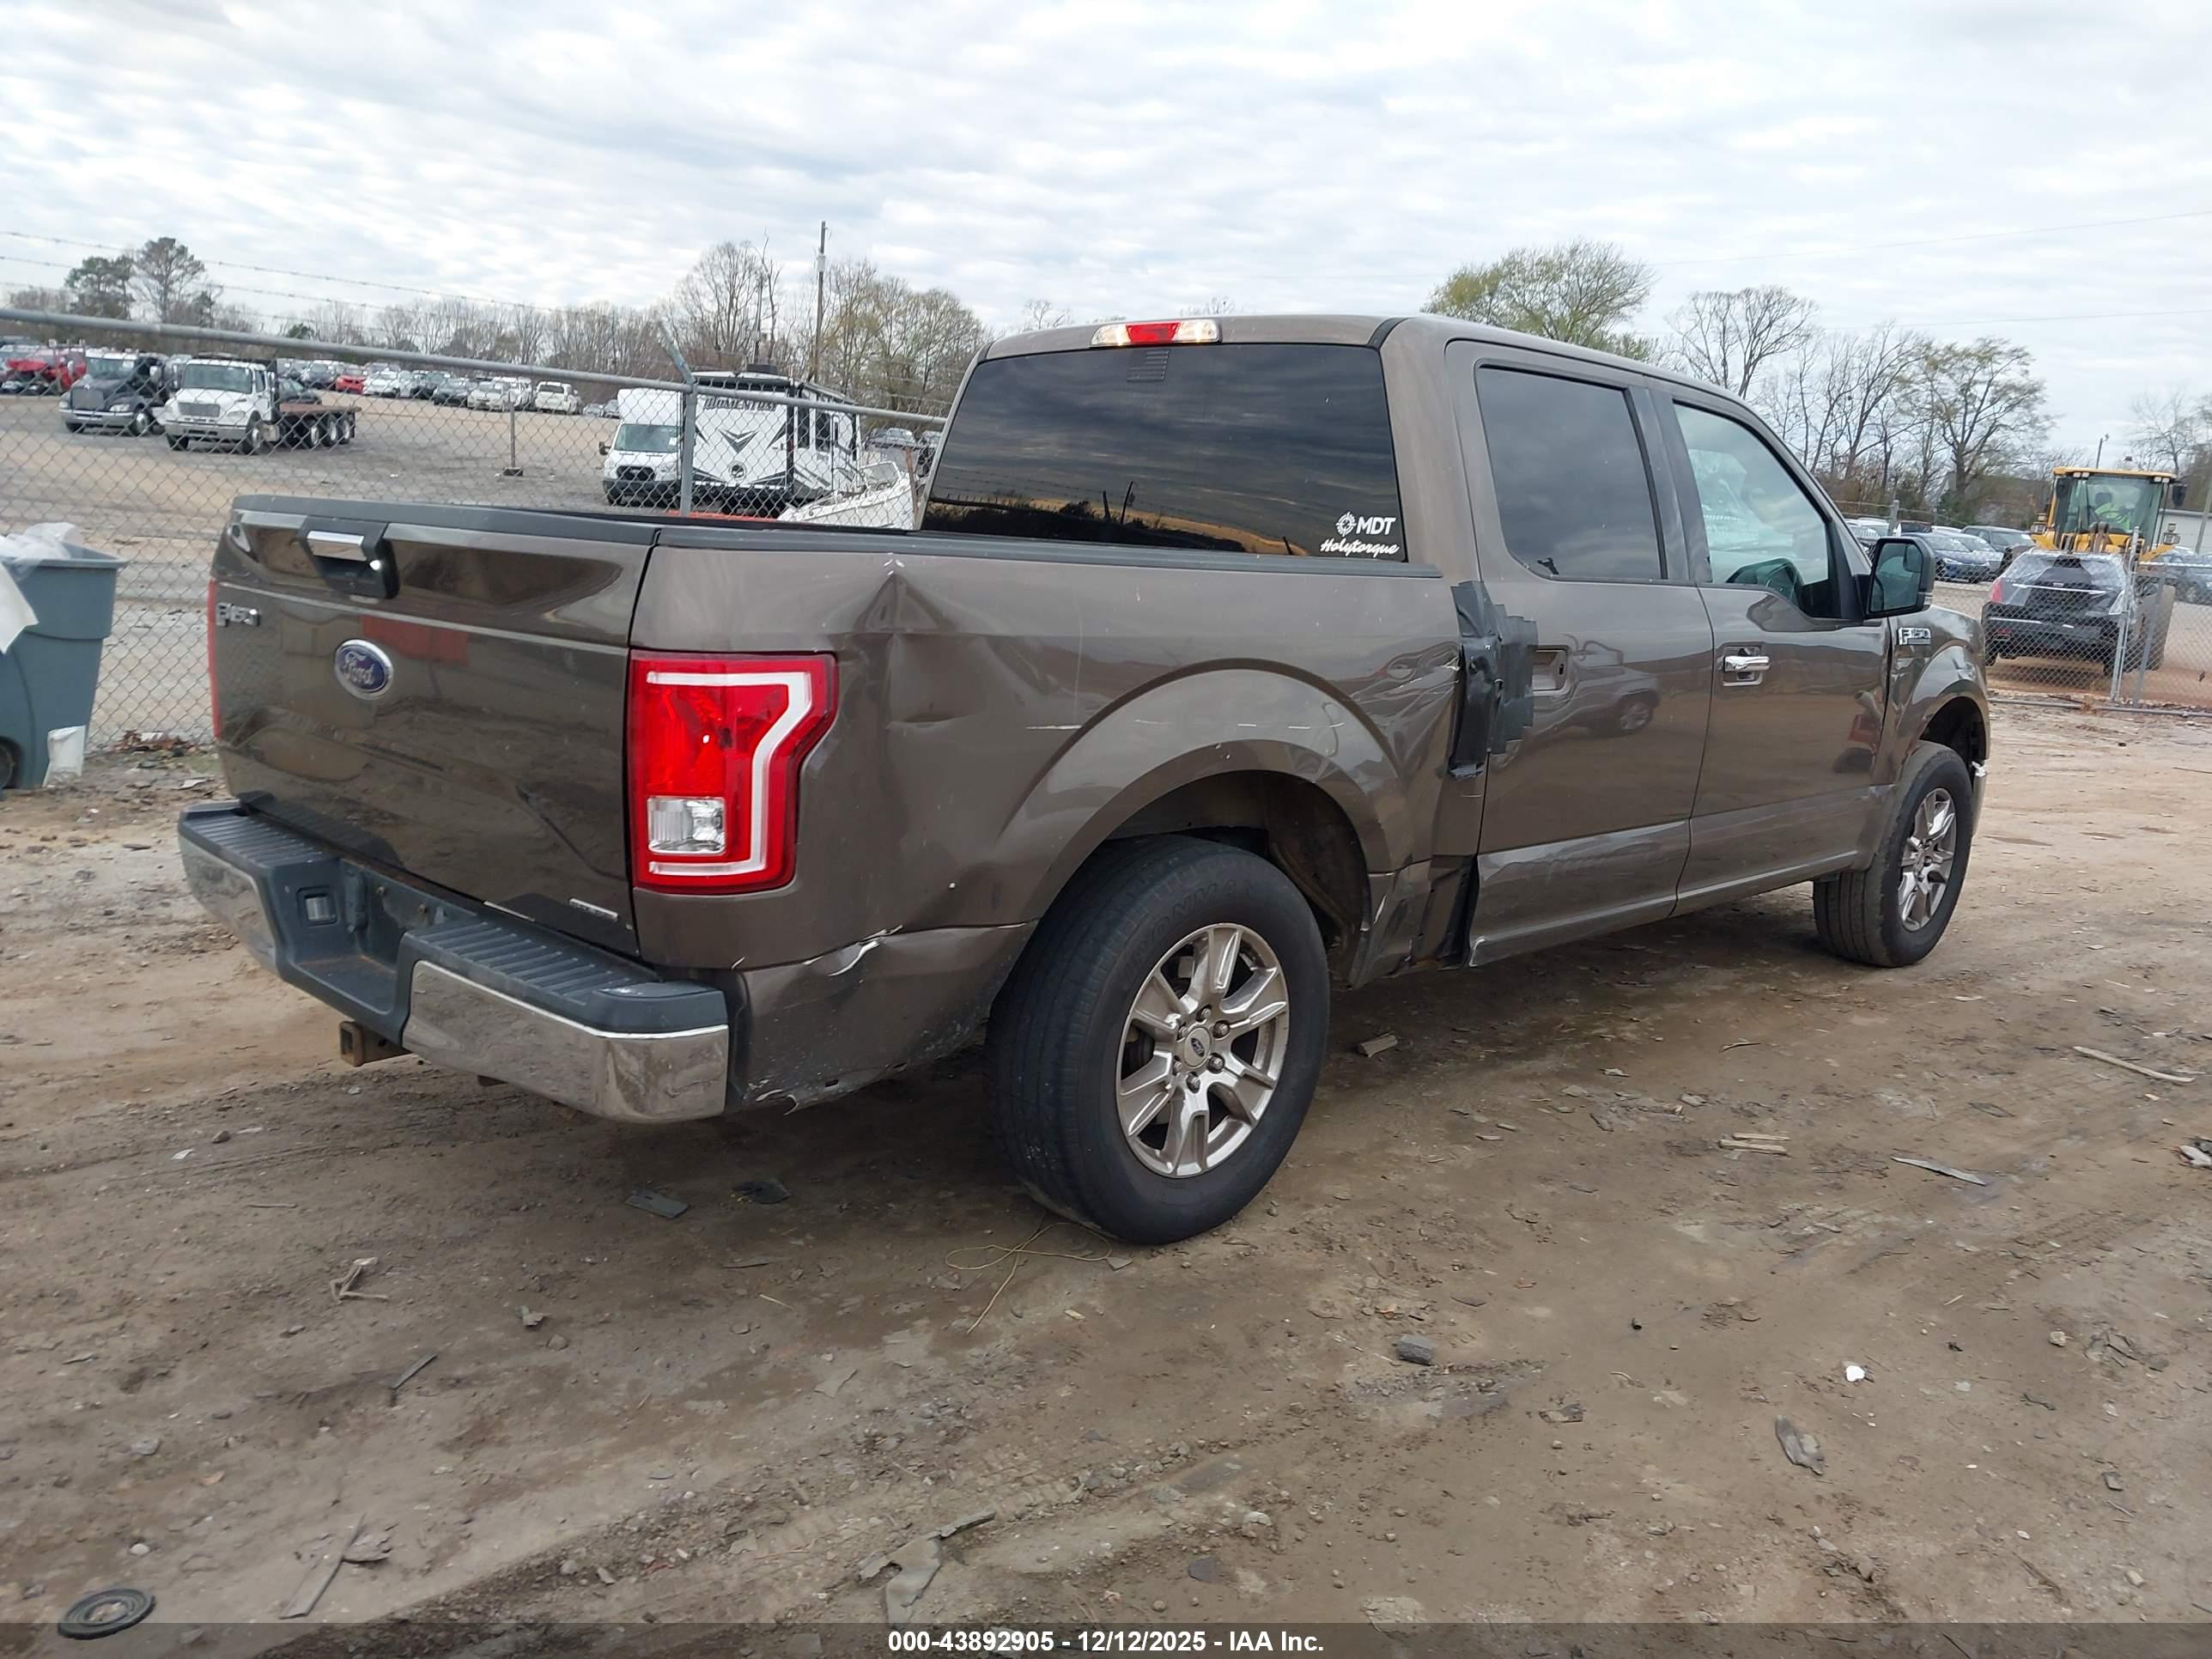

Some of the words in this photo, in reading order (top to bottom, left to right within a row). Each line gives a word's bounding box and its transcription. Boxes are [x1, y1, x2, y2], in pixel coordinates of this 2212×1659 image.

[1356, 516, 1396, 535] MDT
[1320, 538, 1400, 557] Holytorque
[343, 649, 376, 686] Ford
